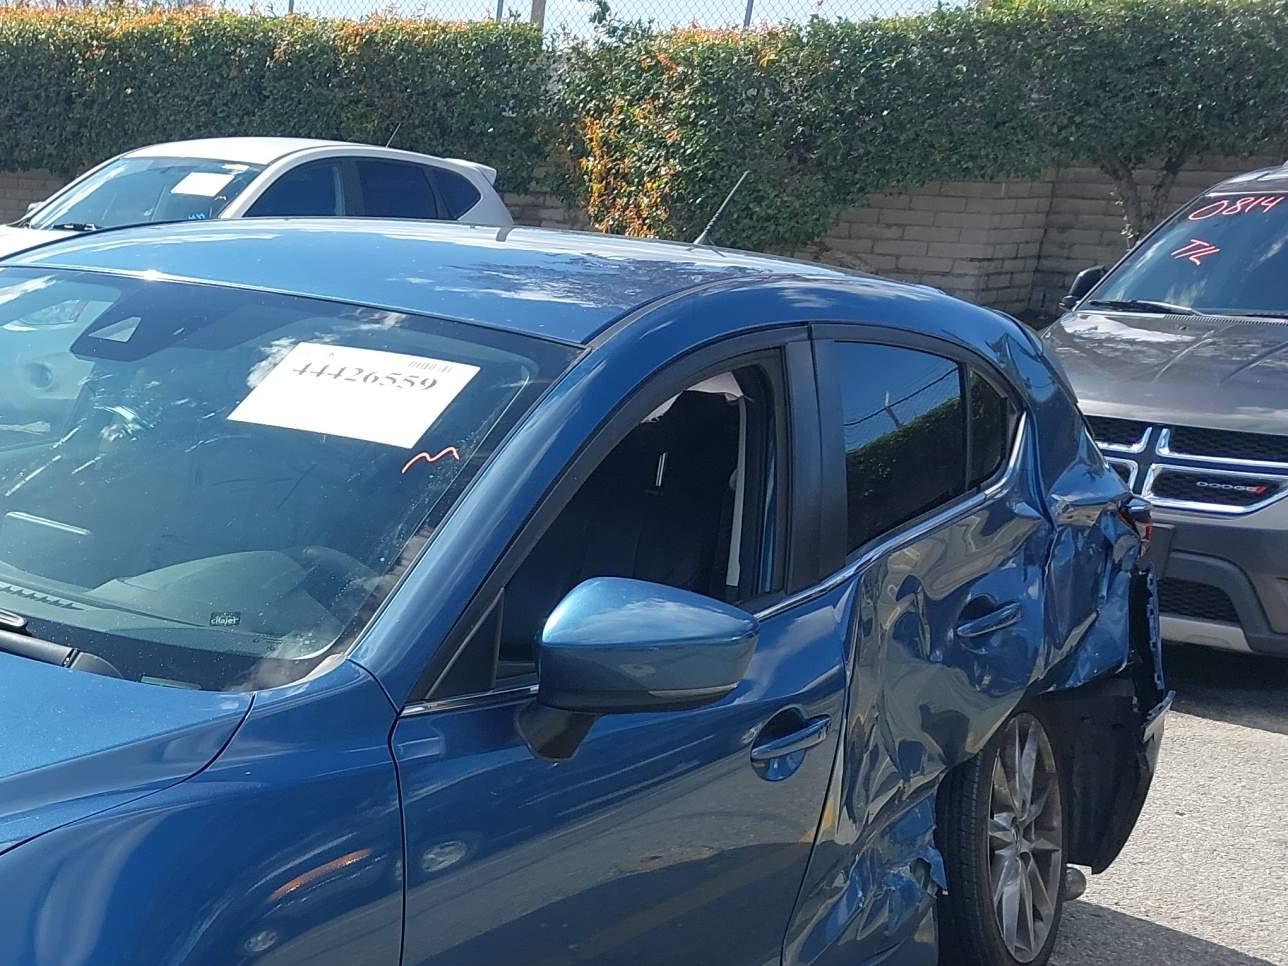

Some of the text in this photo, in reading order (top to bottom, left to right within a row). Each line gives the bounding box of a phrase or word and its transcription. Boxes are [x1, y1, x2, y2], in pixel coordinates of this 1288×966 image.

[1187, 196, 1286, 221] 0814
[292, 361, 438, 391] 44426559
[1195, 481, 1257, 492] DODGE
